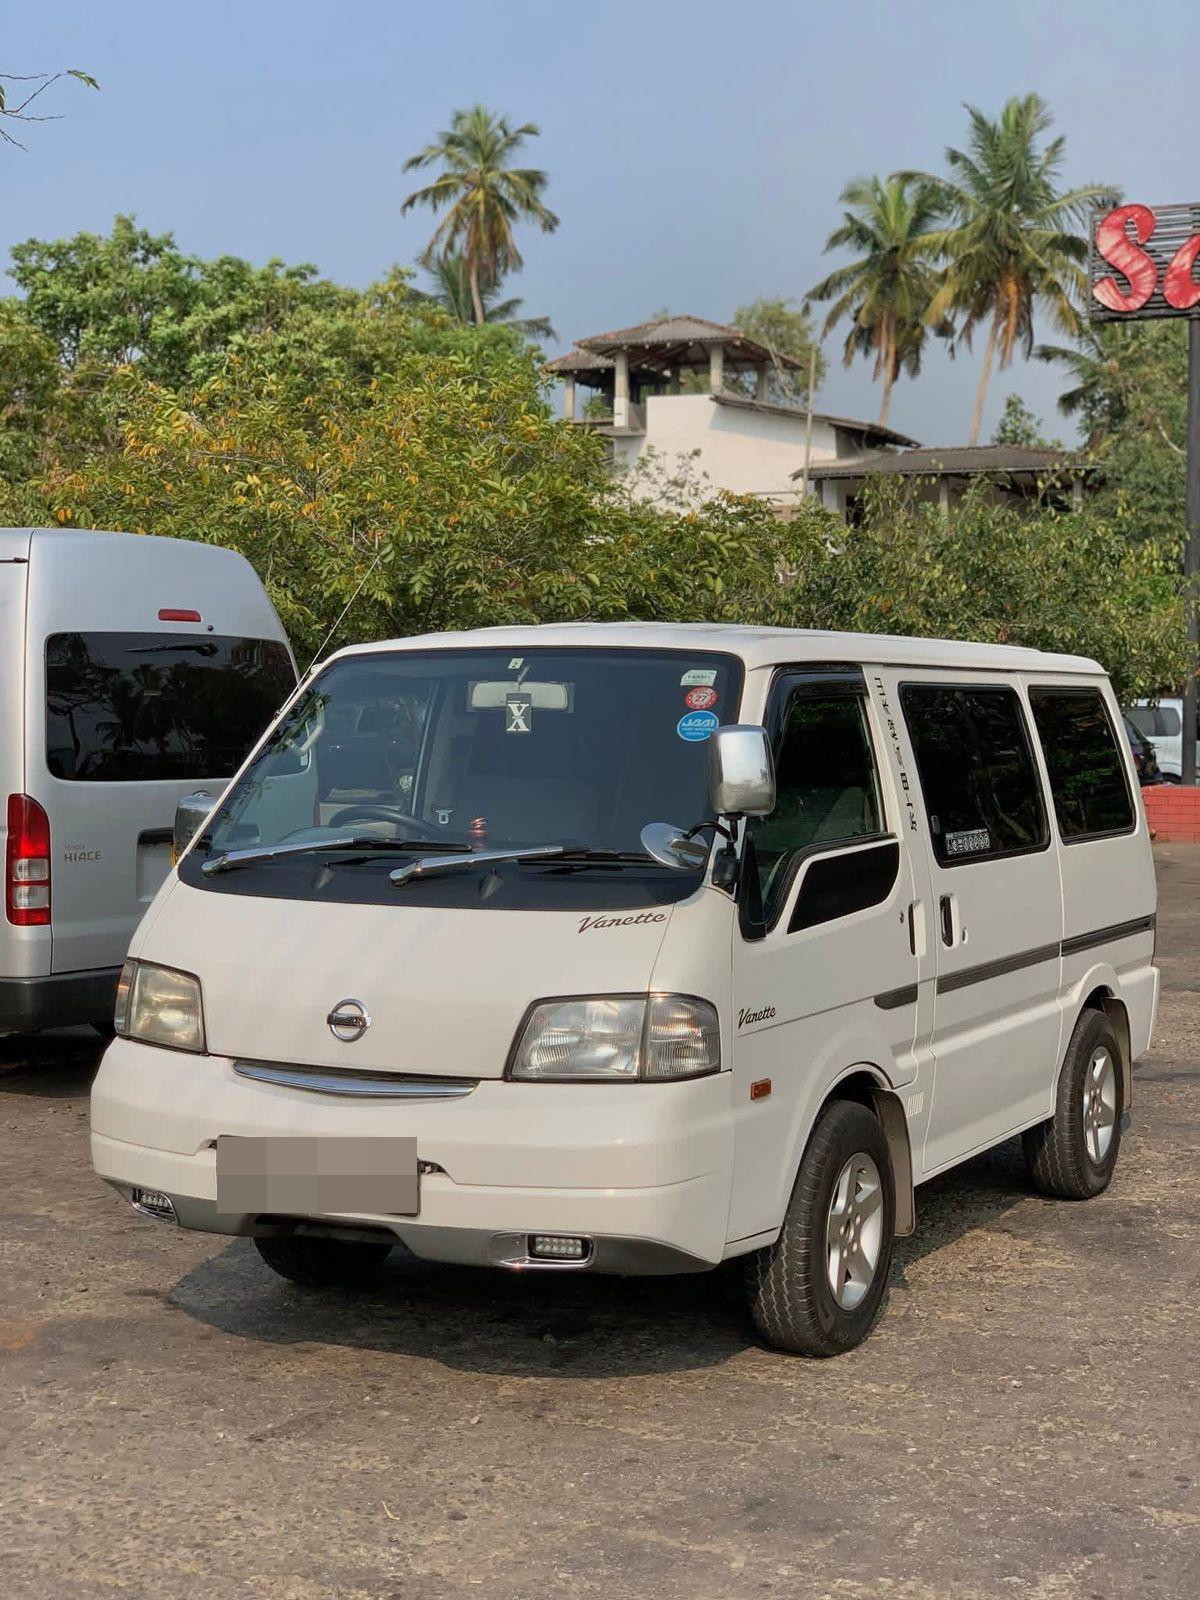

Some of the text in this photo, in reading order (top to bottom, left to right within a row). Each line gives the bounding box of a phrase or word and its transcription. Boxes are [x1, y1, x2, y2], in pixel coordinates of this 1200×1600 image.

[64, 851, 102, 863] HIACE
[577, 912, 668, 934] Vanette
[738, 1005, 776, 1030] Vanette
